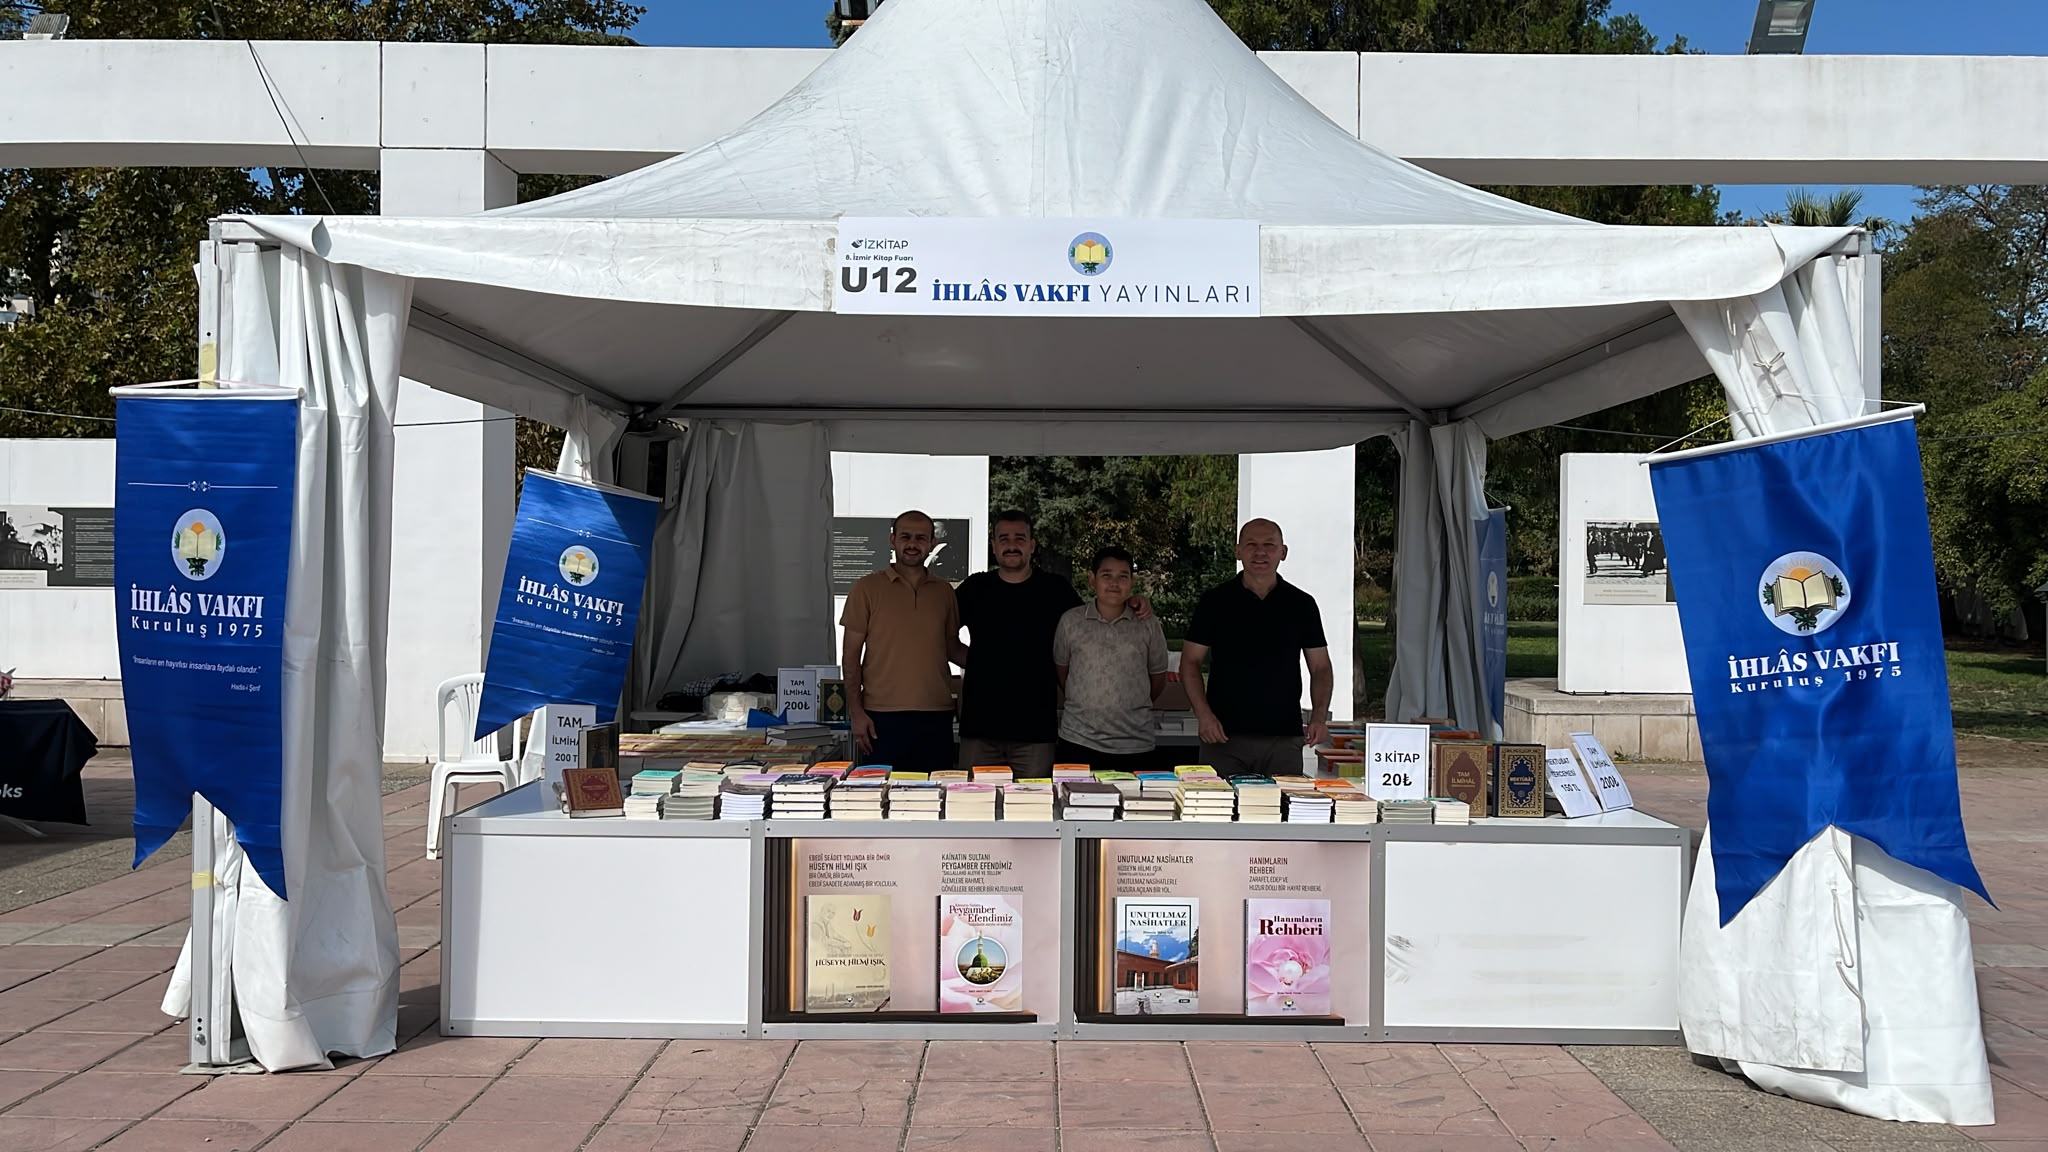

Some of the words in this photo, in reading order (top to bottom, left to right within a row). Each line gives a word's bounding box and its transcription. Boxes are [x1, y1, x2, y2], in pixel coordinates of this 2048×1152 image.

[864, 238, 909, 249] İZKİTAP
[853, 253, 871, 261] İzmir
[874, 254, 893, 262] Kitap
[842, 266, 917, 293] U12
[932, 278, 1007, 302] İHLÂS
[1014, 284, 1090, 302] VAKFI
[1100, 285, 1250, 303] YAYINLARI
[131, 583, 192, 615] İHLÂS
[197, 594, 264, 618] VAKFI
[518, 576, 570, 603] İHLÂS
[574, 592, 625, 616] VAKFI
[516, 594, 578, 619] Kuruluş
[586, 612, 622, 627] 1975
[132, 616, 207, 638] Kuruluş
[218, 622, 263, 638] 1975
[1728, 648, 1808, 679] İHLÂS
[1813, 642, 1901, 670] VAKFI
[189, 662, 216, 671] insanlara
[217, 664, 236, 674] faydalı
[1730, 675, 1824, 694] Kuruluş
[1844, 666, 1902, 682] 1975
[784, 688, 811, 696] İLMİHAL
[558, 716, 582, 728] TAM
[556, 753, 571, 762] 200
[1374, 752, 1382, 762] 3
[1386, 750, 1420, 763] KİTAP
[1382, 773, 1413, 786] 20₺
[0, 784, 23, 798] ks
[1561, 784, 1574, 792] 150
[809, 862, 833, 871] HÜSEYN
[836, 862, 853, 871] HİLMİ
[854, 862, 867, 872] IŞIK
[942, 862, 978, 870] PEYGAMBER
[980, 861, 1012, 870] EFENDİMİZ
[1250, 857, 1288, 865] HANIMLARIN
[1250, 866, 1275, 874] REHBERİ
[950, 905, 996, 916] Peygamber
[968, 914, 1013, 923] Efendimiz
[1130, 918, 1187, 927] NASİHATLER
[1260, 919, 1323, 935] Rehberi
[816, 958, 847, 967] HÜSEYN
[848, 958, 869, 966] HİLMİ
[870, 958, 885, 966] IŞIK
